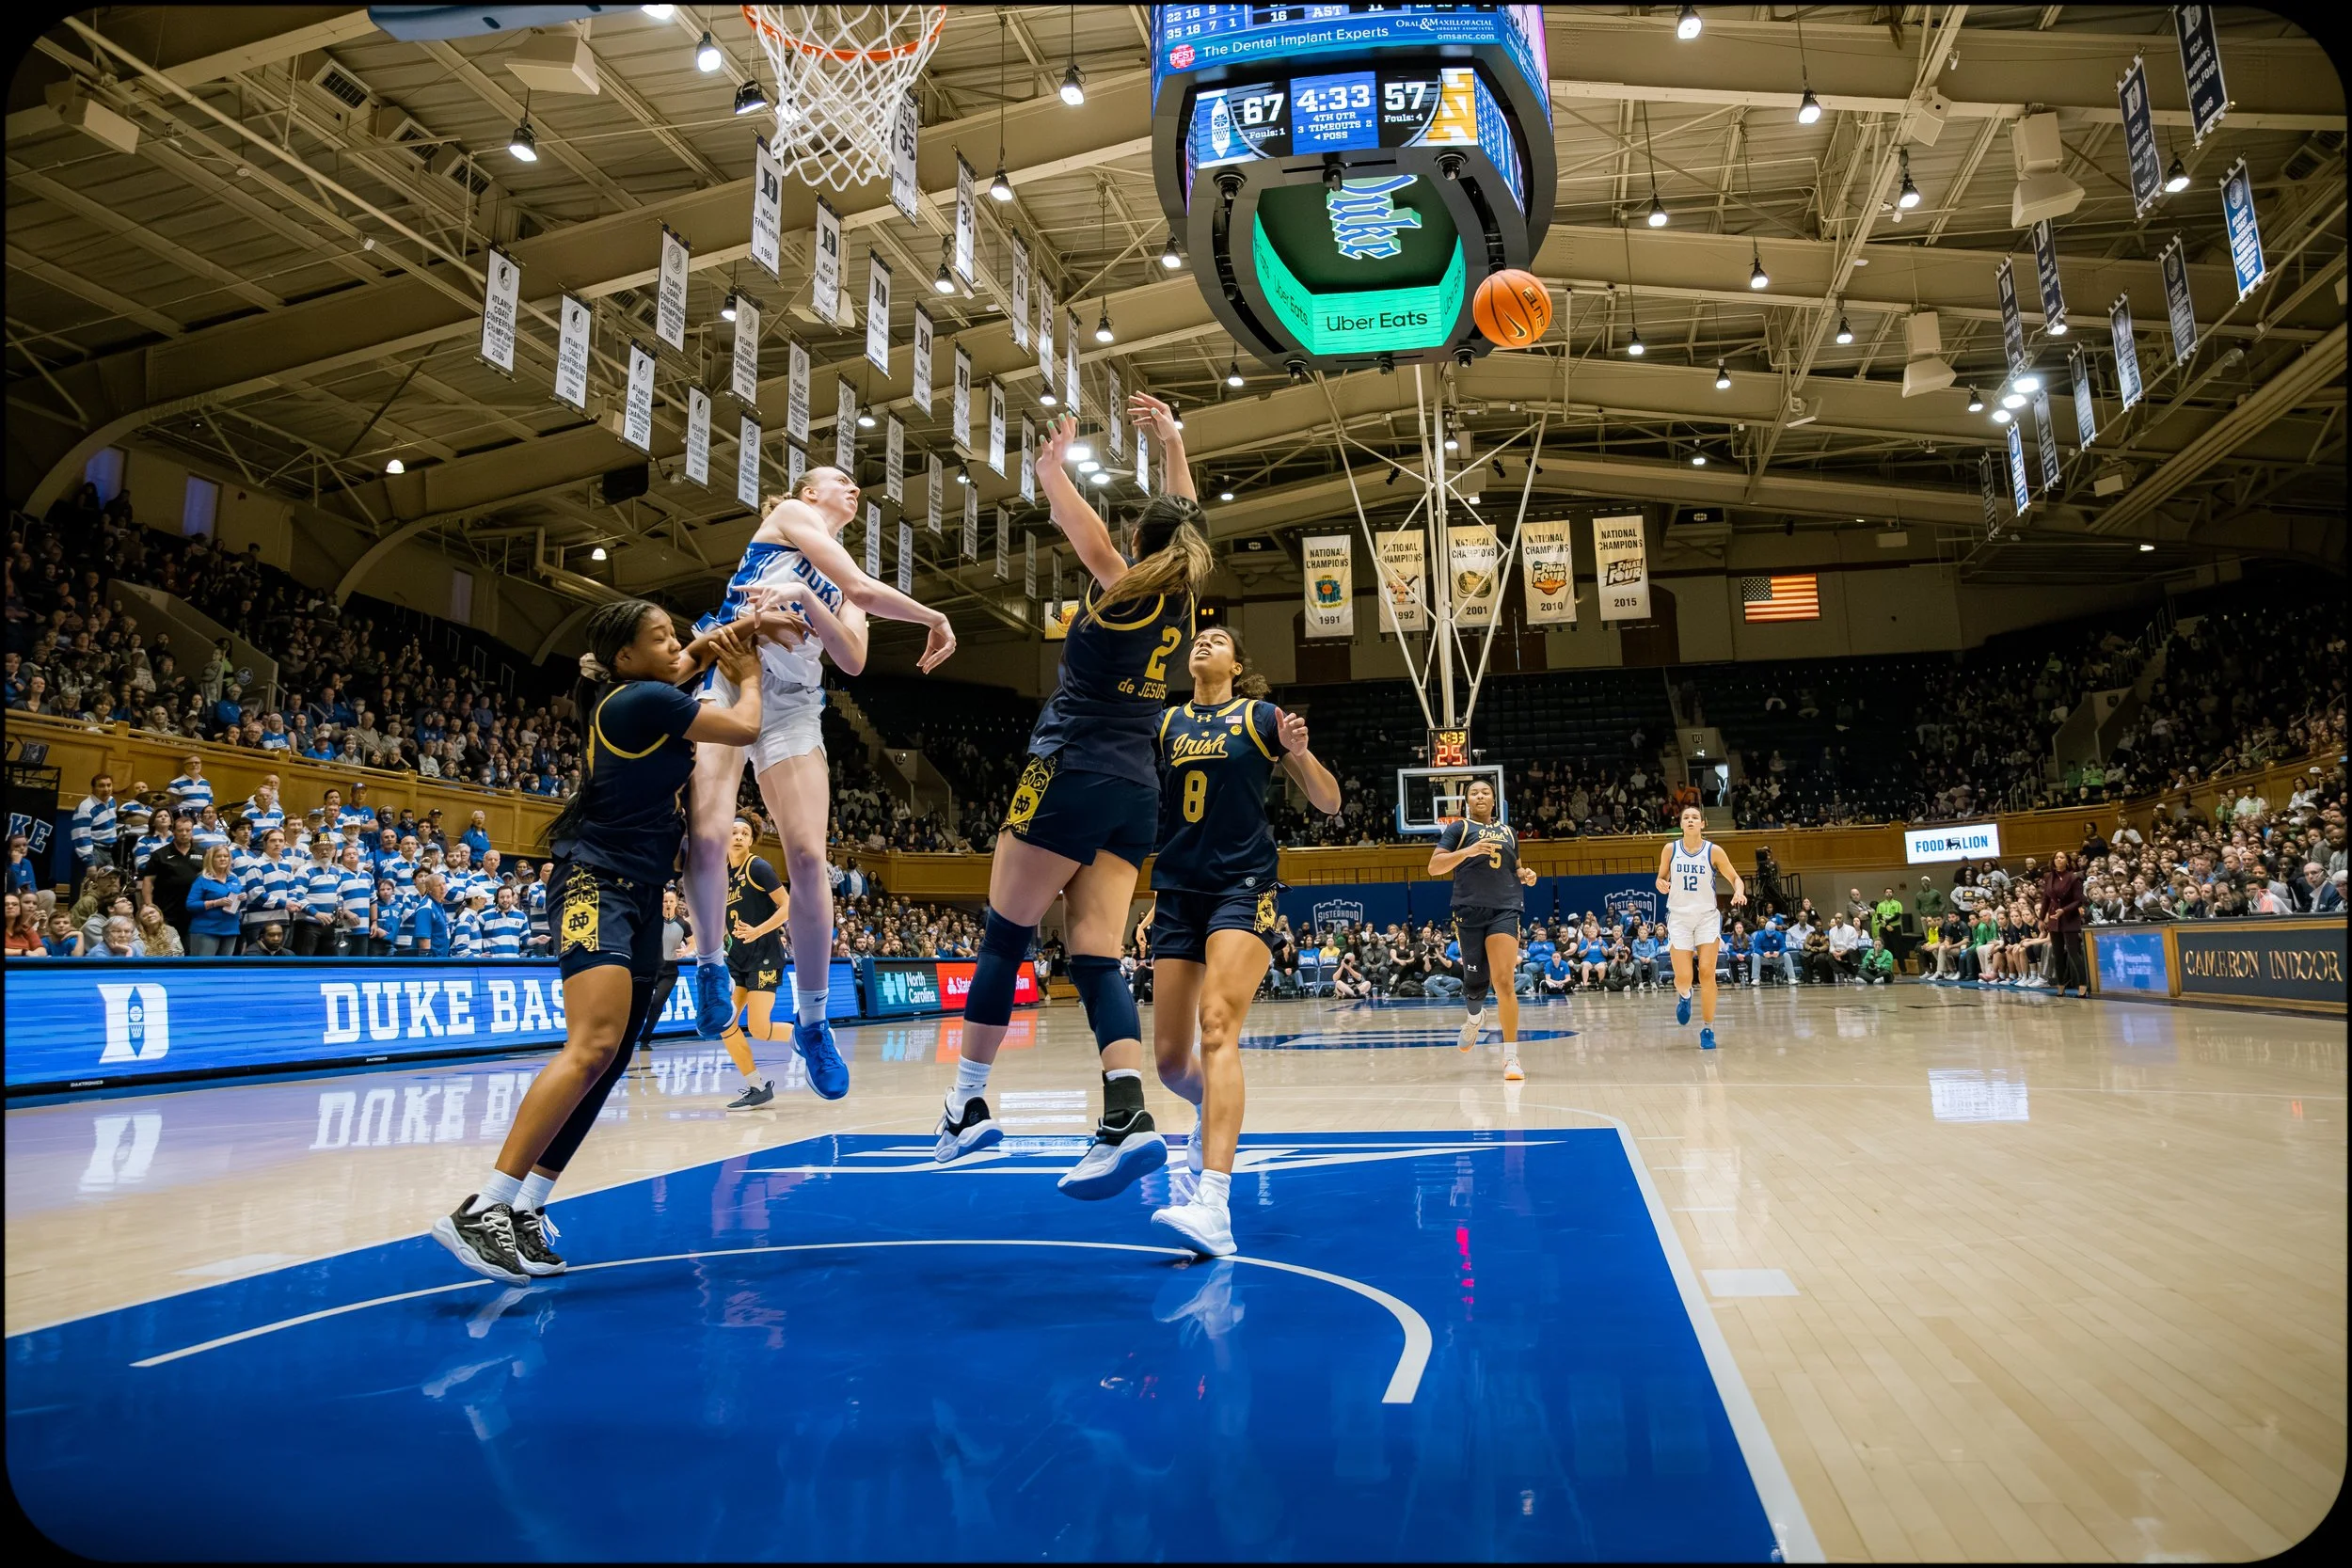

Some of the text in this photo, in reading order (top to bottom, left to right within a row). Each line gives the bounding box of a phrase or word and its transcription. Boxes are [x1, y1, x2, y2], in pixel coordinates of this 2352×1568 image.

[1167, 12, 1181, 24] 22
[1185, 9, 1200, 20] 16
[1208, 5, 1216, 14] 5
[1270, 11, 1287, 23] 16
[1311, 5, 1343, 18] AST
[1167, 18, 1236, 40] 35 18 7 1
[1203, 27, 1390, 57] The Dental Implant Experts
[1437, 32, 1495, 40] omsanc.com
[1169, 50, 1195, 62] BEST
[1295, 84, 1371, 113] 4:33
[1384, 82, 1426, 111] 57
[1243, 92, 1285, 125] 67
[1312, 111, 1357, 123] 4TH QTR
[1384, 113, 1423, 124] Fouls: 4
[1308, 120, 1361, 133] TIMEOUTS
[1365, 119, 1373, 128] 2
[1248, 127, 1286, 140] Fouls: 1
[1323, 131, 1348, 141] POSS
[899, 123, 915, 162] 35
[1327, 310, 1428, 332] Uber Eats
[1528, 533, 1564, 544] NATIONAL
[1601, 529, 1638, 539] NATIONAL
[1525, 544, 1569, 555] CHAMPIONS
[1598, 539, 1643, 550] CHAMPIONS
[1310, 547, 1345, 558] NATIONAL
[1306, 558, 1349, 569] CHAMPIONS
[1617, 559, 1642, 571] FINAL
[1533, 570, 1566, 583] FOUR
[1609, 566, 1642, 584] FOUR
[1540, 601, 1564, 611] 2010
[1613, 597, 1637, 608] 2015
[1394, 610, 1415, 621] 992
[1466, 606, 1487, 615] 2001
[1319, 615, 1341, 625] 1991
[1144, 626, 1182, 681] 2
[1118, 678, 1168, 701] de JESUS
[1439, 732, 1466, 744] 4:33
[1170, 733, 1228, 760] Irish
[1437, 745, 1463, 766] 25
[1183, 770, 1207, 823] 8
[6, 812, 54, 855] KE
[1478, 829, 1508, 842] Irish
[1915, 835, 1989, 853] FOOD LION
[1488, 844, 1502, 869] 5
[1677, 863, 1706, 875] DUKE
[1683, 875, 1698, 892] 12
[1317, 910, 1359, 922] SISTERHOOD
[2185, 949, 2344, 983] CAMERON INDOOR
[905, 971, 927, 987] North
[908, 986, 936, 1004] Carolina
[320, 979, 475, 1045] DUKE
[70, 1079, 104, 1088] DAKTRONICS
